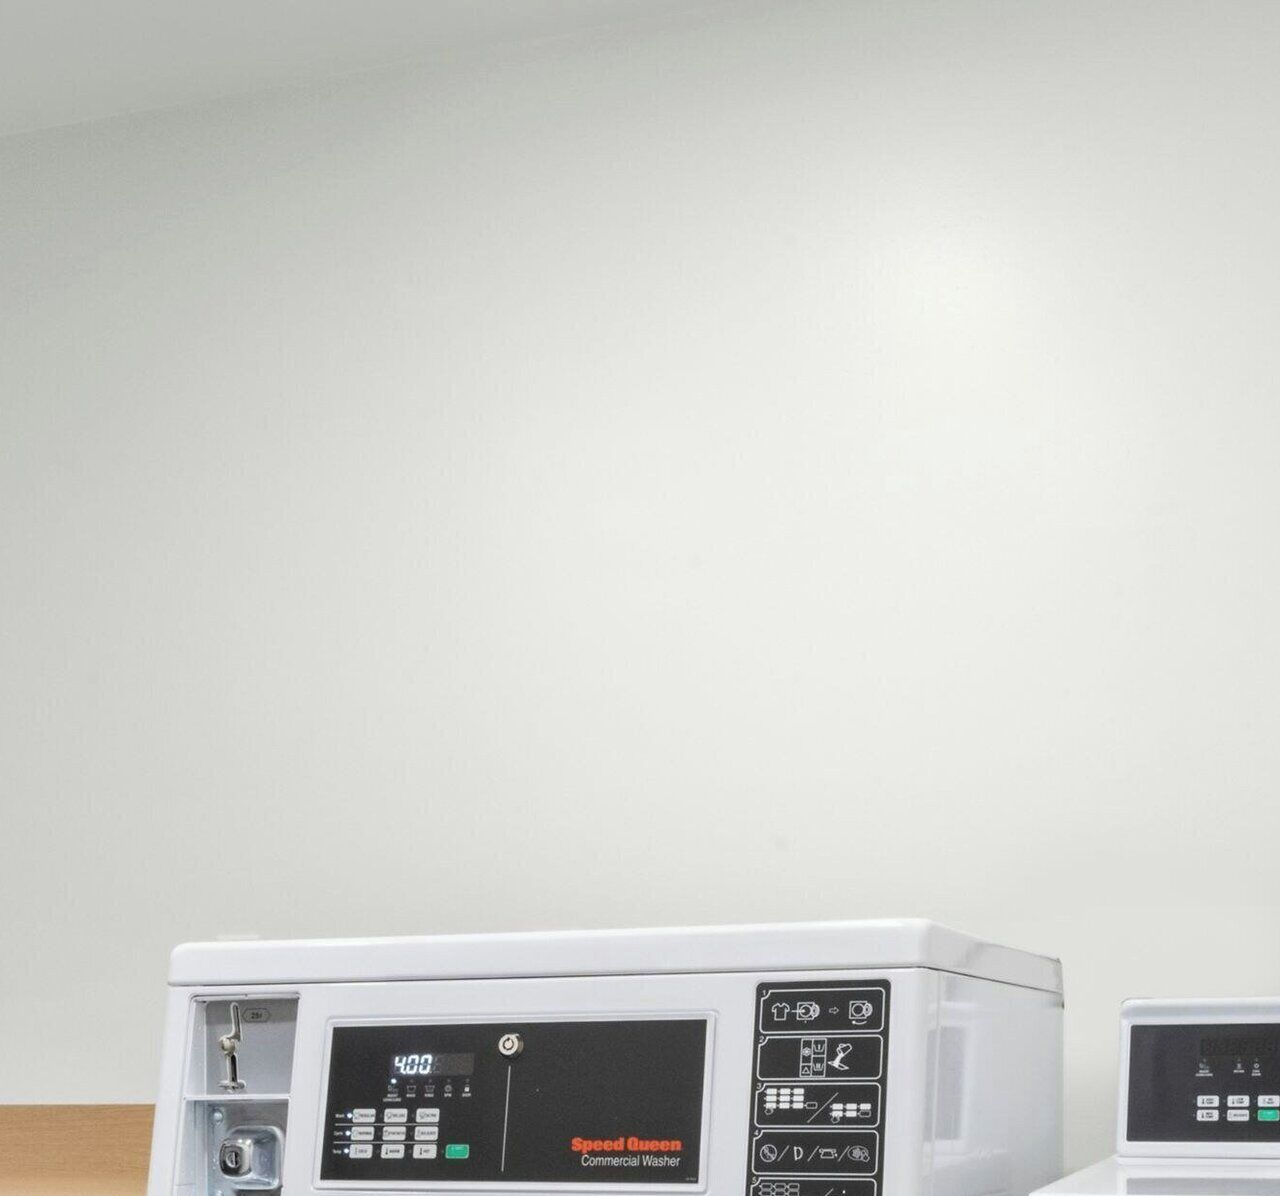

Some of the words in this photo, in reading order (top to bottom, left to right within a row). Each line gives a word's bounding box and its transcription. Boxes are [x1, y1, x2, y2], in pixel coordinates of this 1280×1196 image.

[571, 1136, 625, 1154] Speed
[626, 1136, 682, 1152] Queen
[581, 1154, 640, 1167] Commercial
[641, 1154, 681, 1167] Washer
